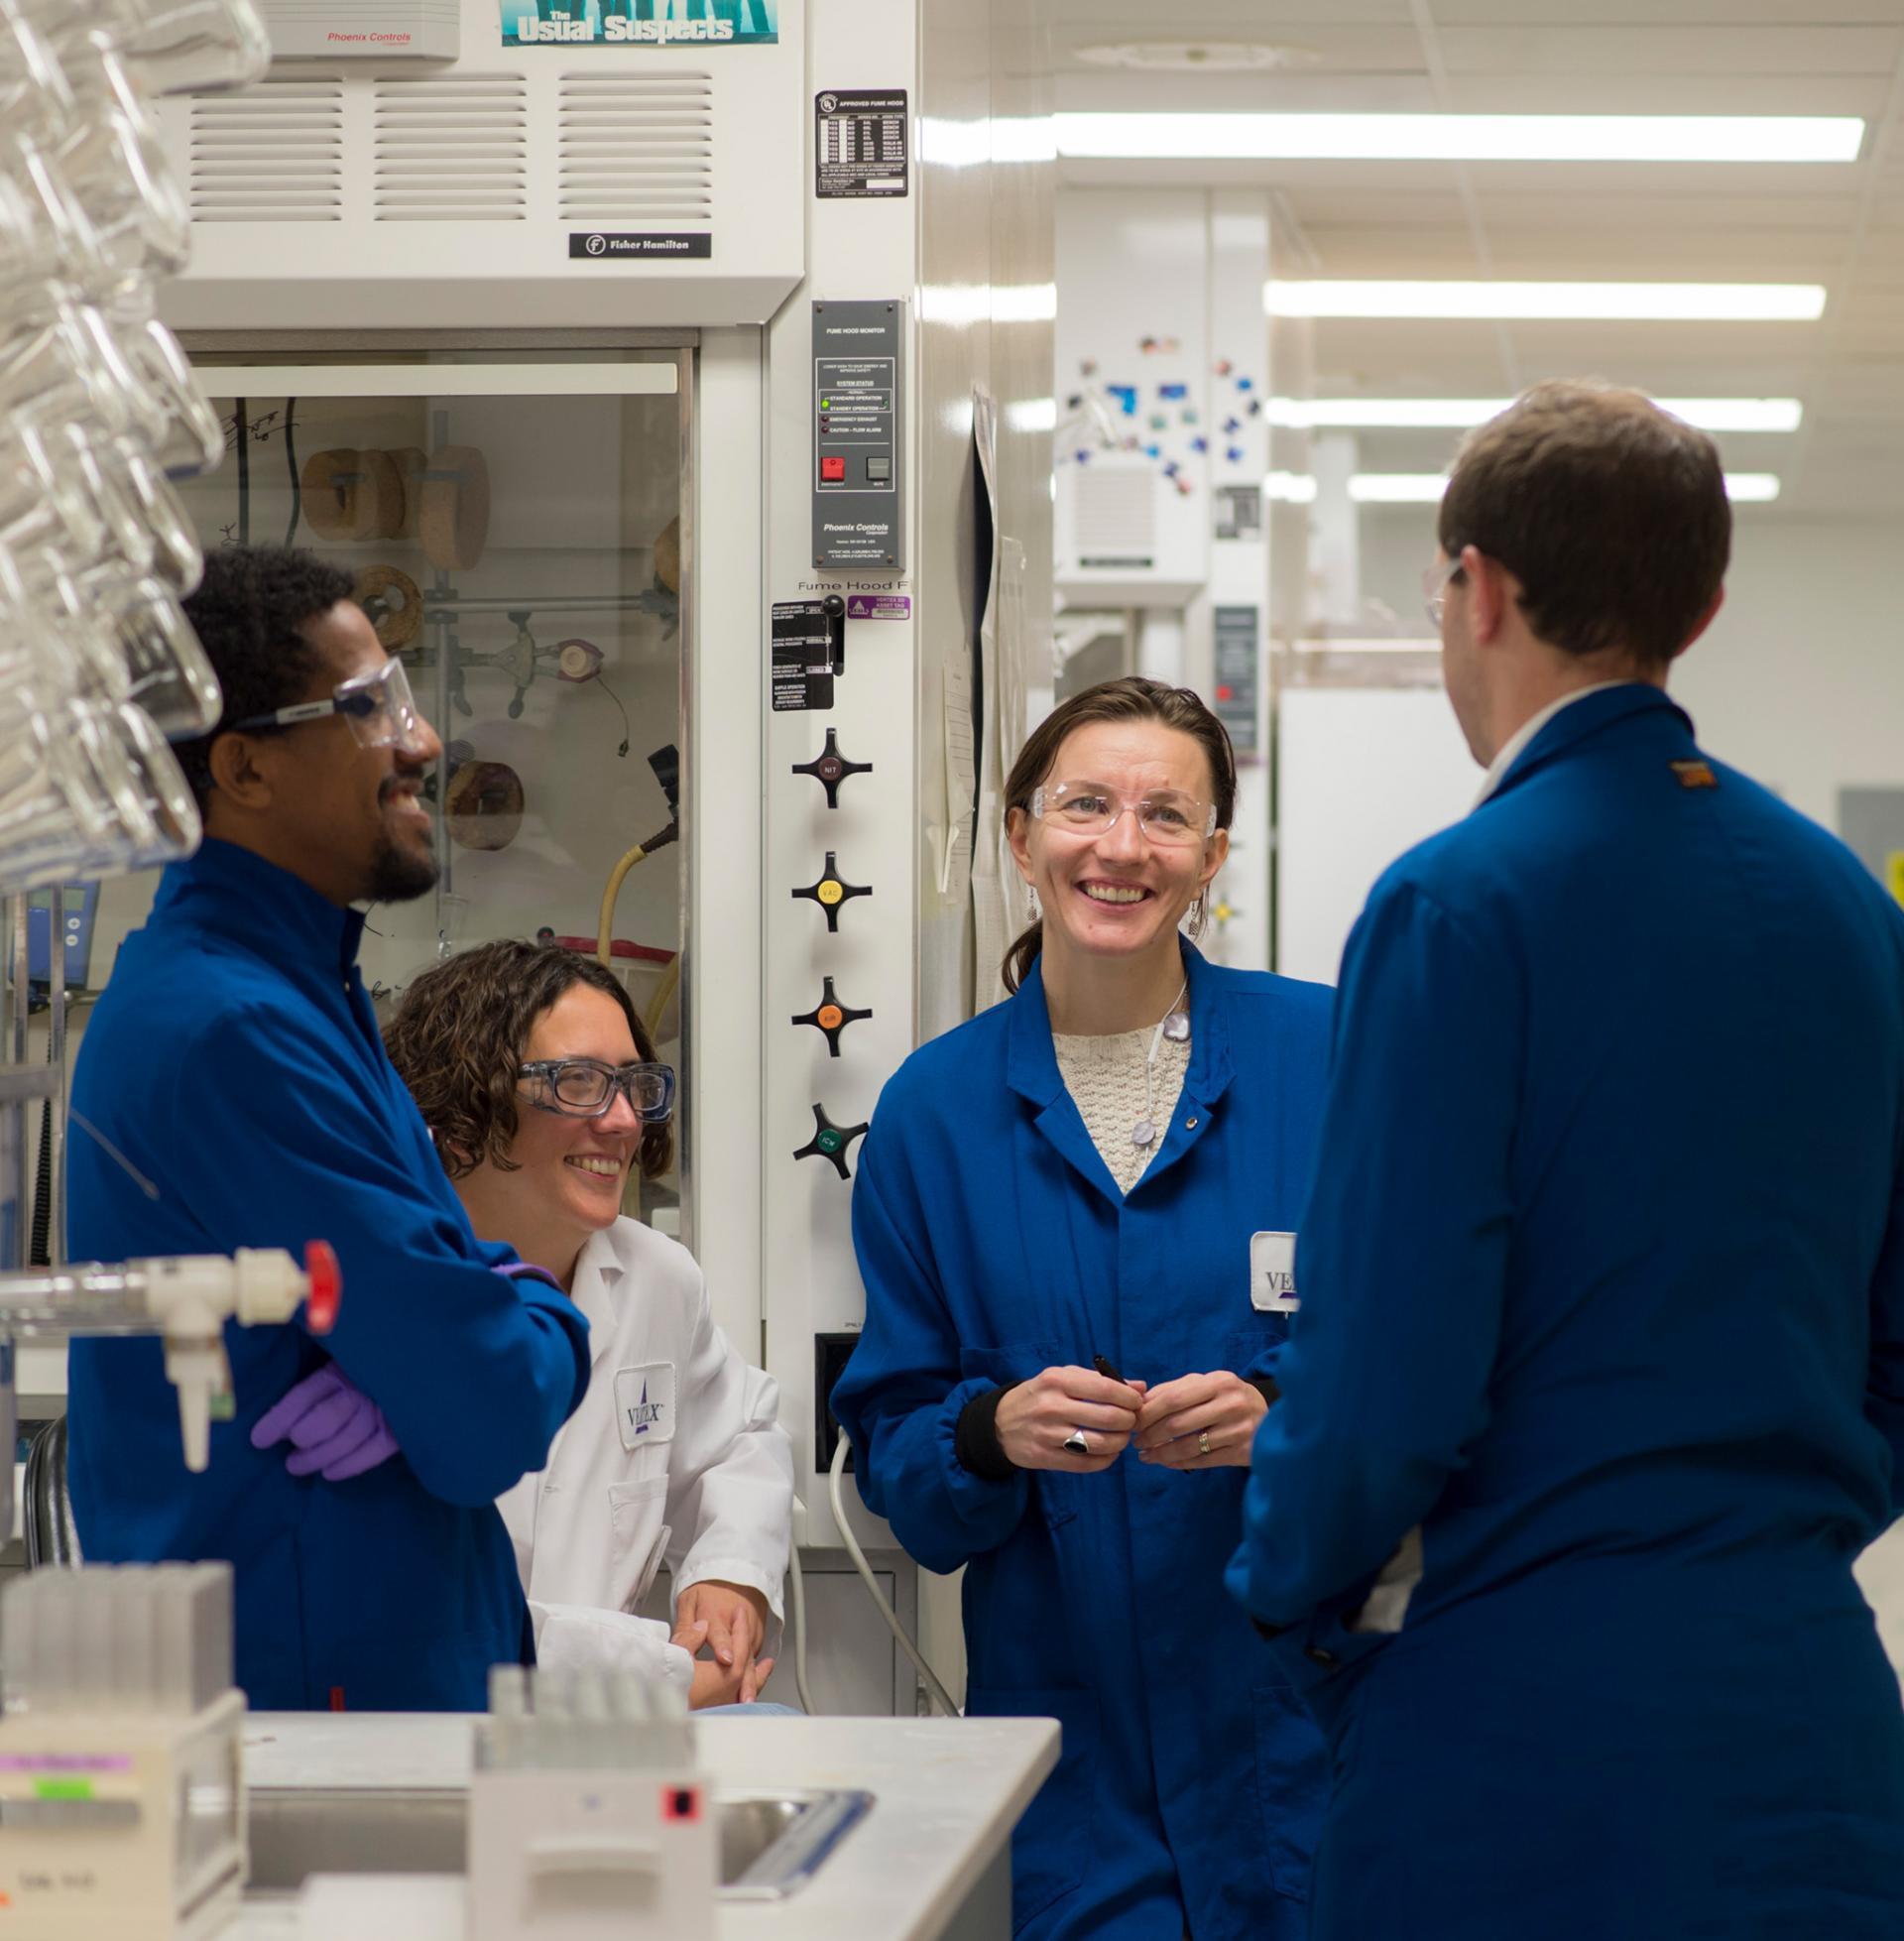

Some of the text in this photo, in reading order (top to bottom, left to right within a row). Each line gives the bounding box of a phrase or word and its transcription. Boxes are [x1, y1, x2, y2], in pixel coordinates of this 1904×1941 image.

[550, 10, 570, 20] The
[518, 15, 734, 44] Usual Suspects
[327, 32, 411, 41] Phoenix Controls
[610, 240, 641, 249] Fisher
[643, 240, 689, 249] Hamilton
[799, 581, 909, 590] Fume Hood F
[1265, 1272, 1293, 1290] VE
